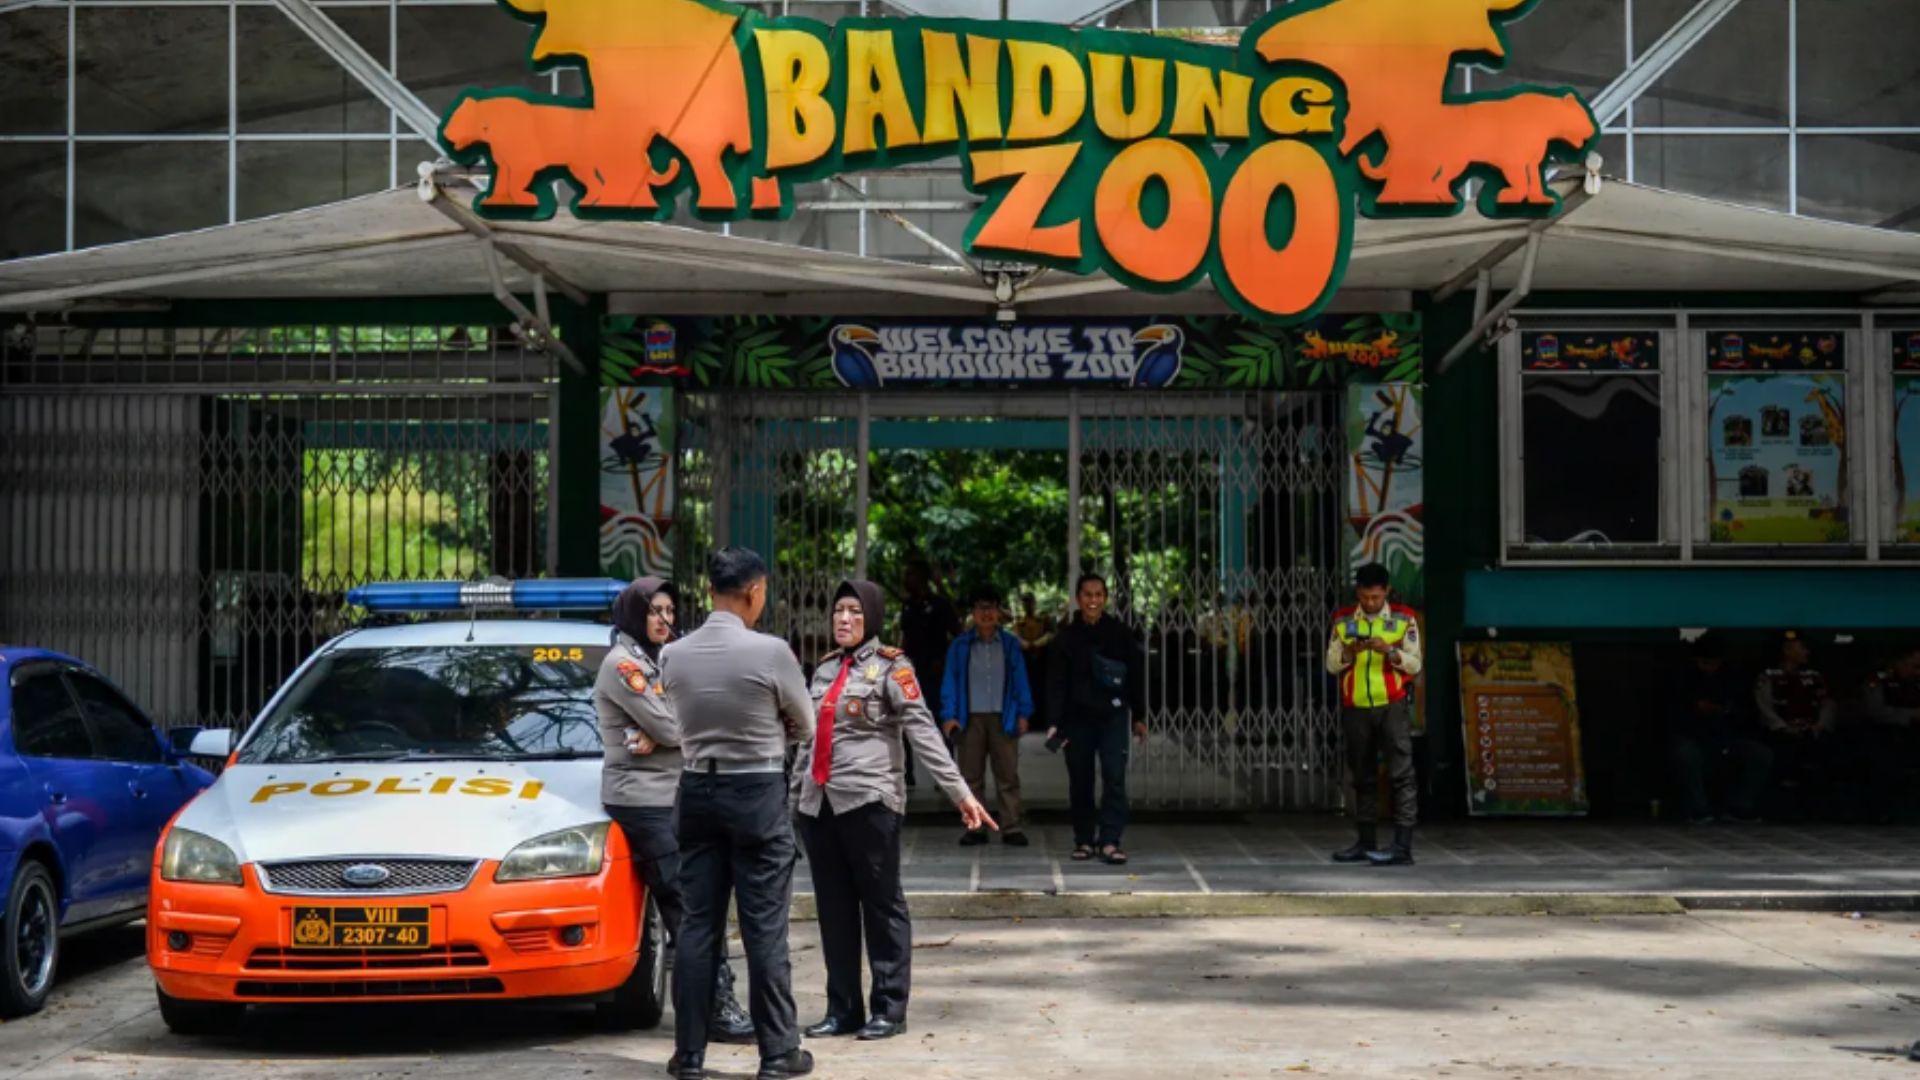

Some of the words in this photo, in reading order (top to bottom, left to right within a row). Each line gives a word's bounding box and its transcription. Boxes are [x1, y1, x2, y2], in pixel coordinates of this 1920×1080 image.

[754, 28, 1335, 170] BANDUNG
[970, 138, 1340, 315] ZOO
[880, 327, 1072, 353] WELCOME
[1084, 327, 1135, 353] TO
[876, 353, 1053, 379] BANDUNG
[1063, 353, 1135, 379] ZOO
[533, 647, 584, 662] 20.5
[251, 777, 544, 803] POLISI
[364, 906, 398, 922] VIII
[343, 927, 419, 943] 2307-40
